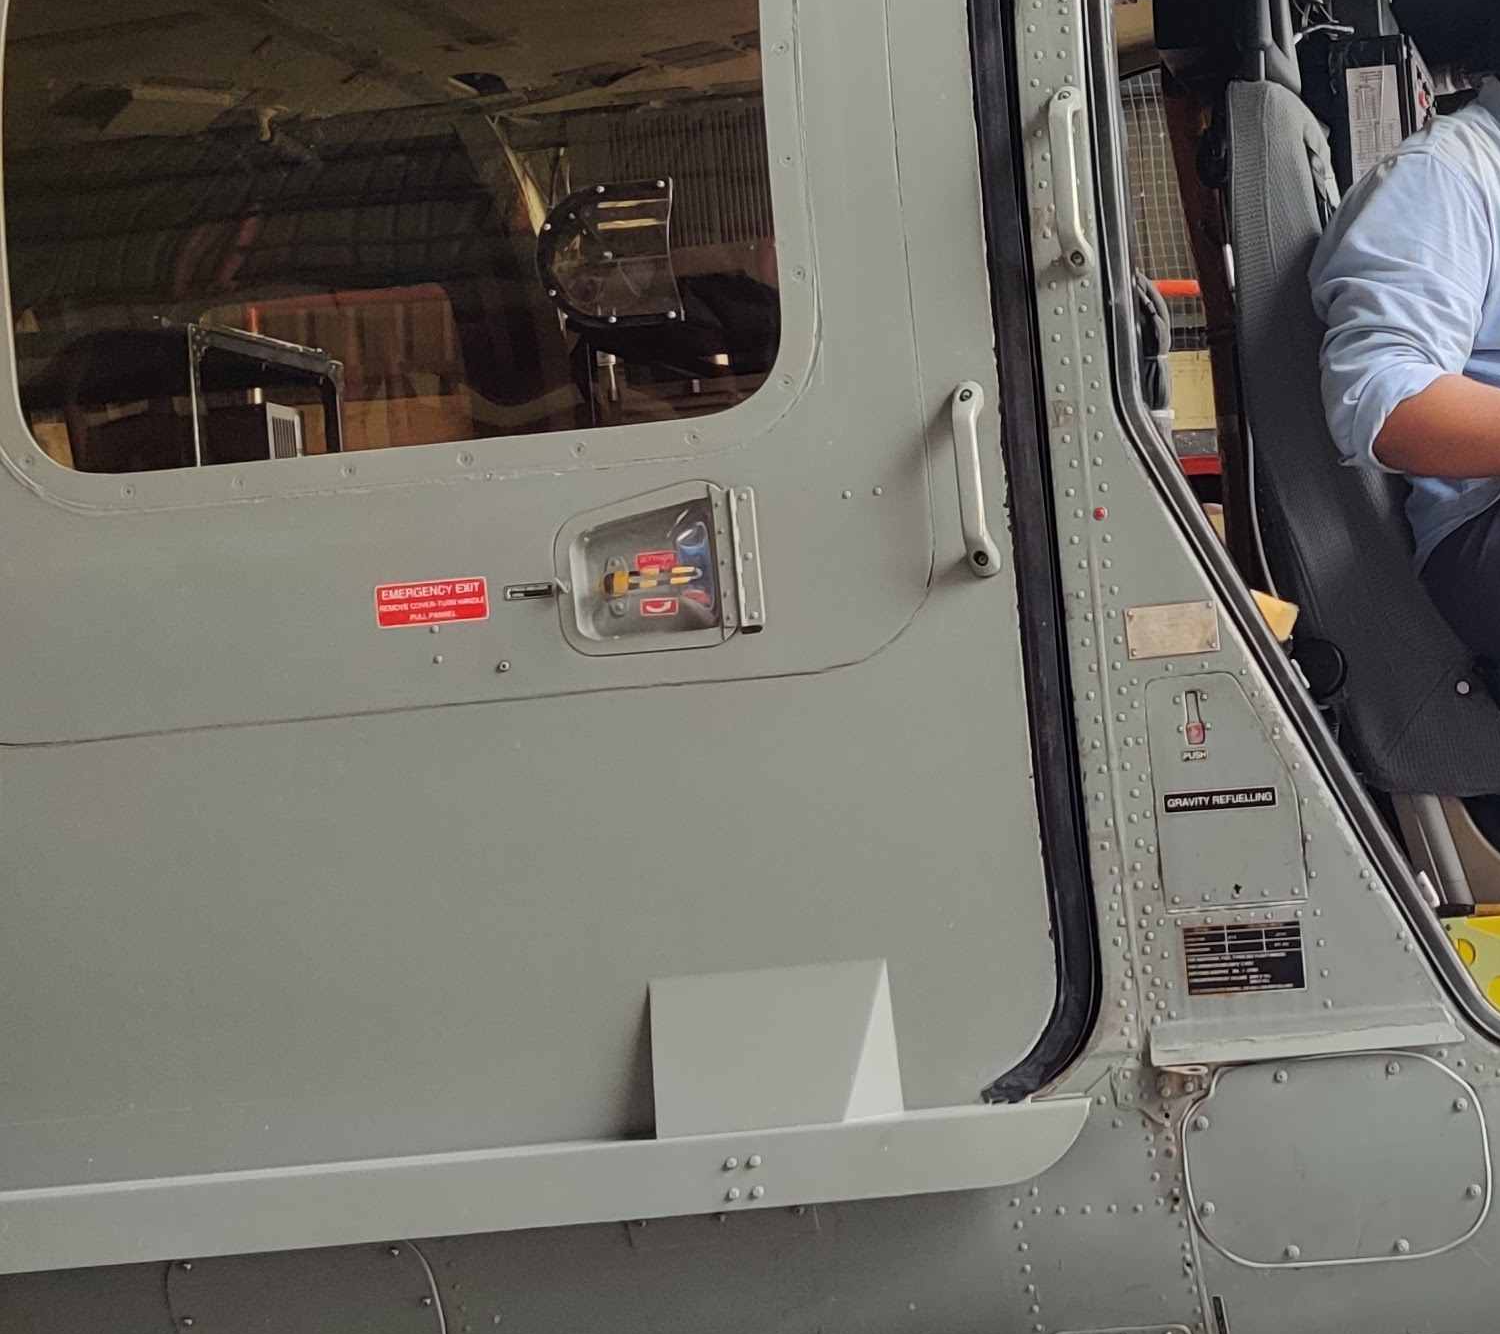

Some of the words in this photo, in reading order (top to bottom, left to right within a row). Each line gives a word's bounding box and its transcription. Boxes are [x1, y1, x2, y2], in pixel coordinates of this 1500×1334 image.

[382, 585, 452, 600] EMERGENCY
[455, 582, 480, 593] EXIT
[410, 612, 427, 620] PULL
[1183, 751, 1206, 759] PUSH
[1167, 796, 1210, 807] GRAVITY
[1212, 792, 1272, 805] REFUELLING
